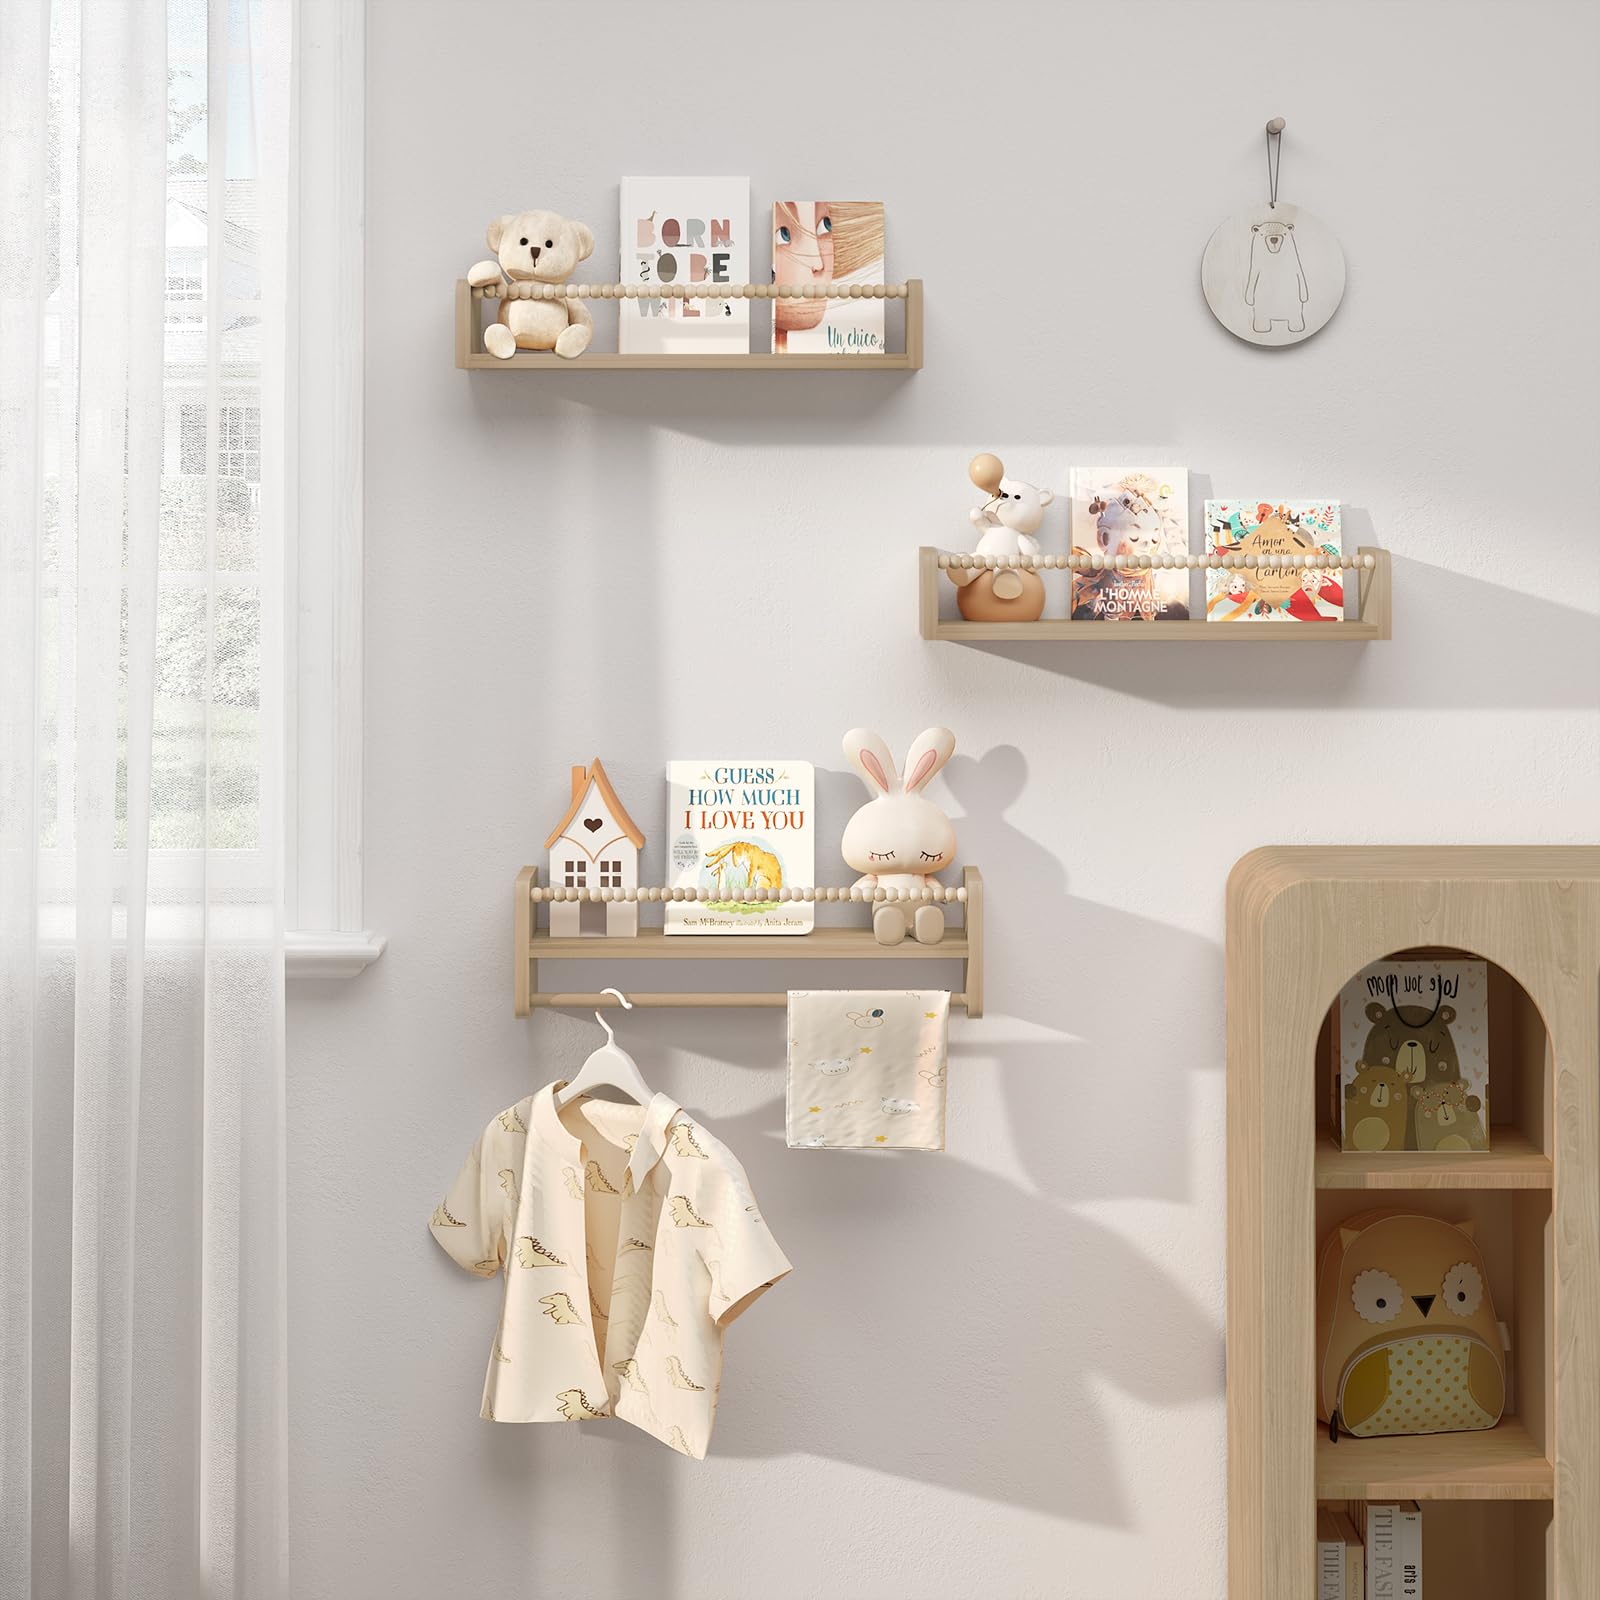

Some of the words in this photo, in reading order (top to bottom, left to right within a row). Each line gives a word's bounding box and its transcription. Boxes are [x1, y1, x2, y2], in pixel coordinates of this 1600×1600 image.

[637, 218, 731, 248] BORN
[636, 253, 678, 283] TO
[690, 253, 730, 283] BE
[828, 325, 844, 348] Un
[847, 327, 879, 347] chico
[1252, 534, 1285, 549] Amor
[1100, 588, 1160, 601] L'HOMME
[1094, 600, 1168, 613] MONTAGNE
[714, 767, 775, 785] GUESS
[688, 789, 734, 806] HOW
[741, 789, 800, 806] MUCH
[684, 810, 692, 829] I
[700, 810, 754, 830] LOVE
[761, 810, 805, 830] YOU
[1375, 1509, 1393, 1551] THE
[1323, 1545, 1340, 1579] THE
[1404, 1565, 1418, 1584] arts
